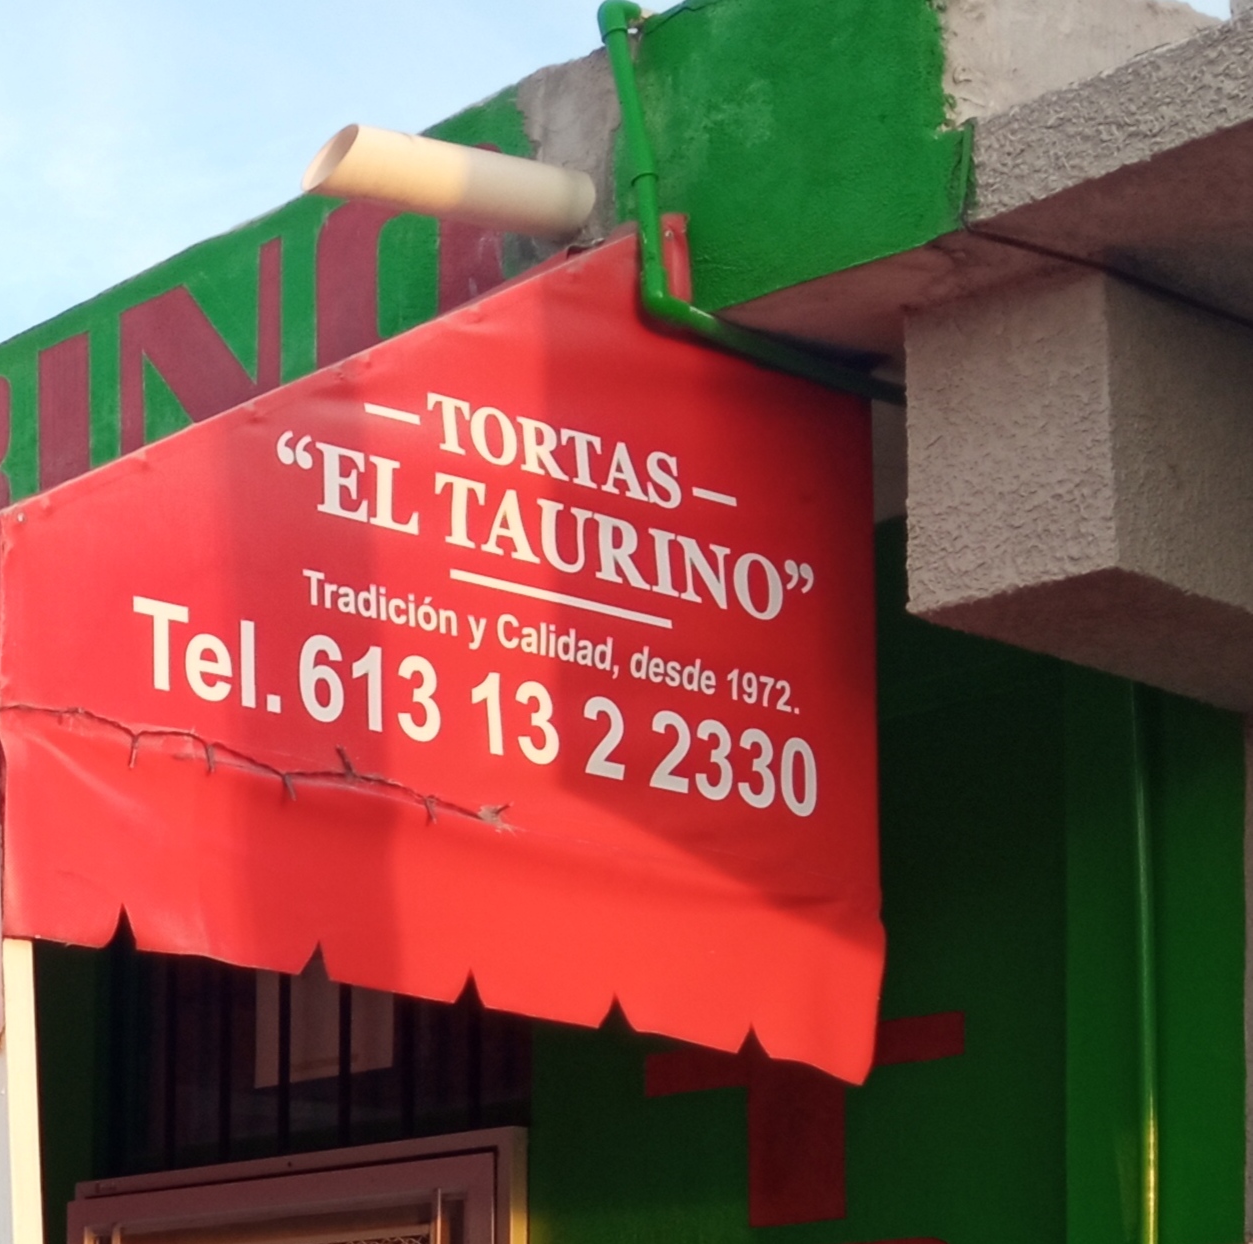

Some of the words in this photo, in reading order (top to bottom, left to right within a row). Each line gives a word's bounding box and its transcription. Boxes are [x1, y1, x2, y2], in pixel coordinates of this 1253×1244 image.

[427, 392, 682, 509] TORTAS
[133, 595, 282, 714] Tel.
[299, 634, 441, 743] 613
[471, 672, 560, 765] 13
[583, 696, 626, 781] 2
[649, 710, 818, 817] 2330
[302, 568, 458, 639] Tradición
[468, 614, 487, 650] y
[496, 613, 620, 679] Calidad,
[630, 646, 716, 697] desde
[726, 668, 801, 716] 1972.
